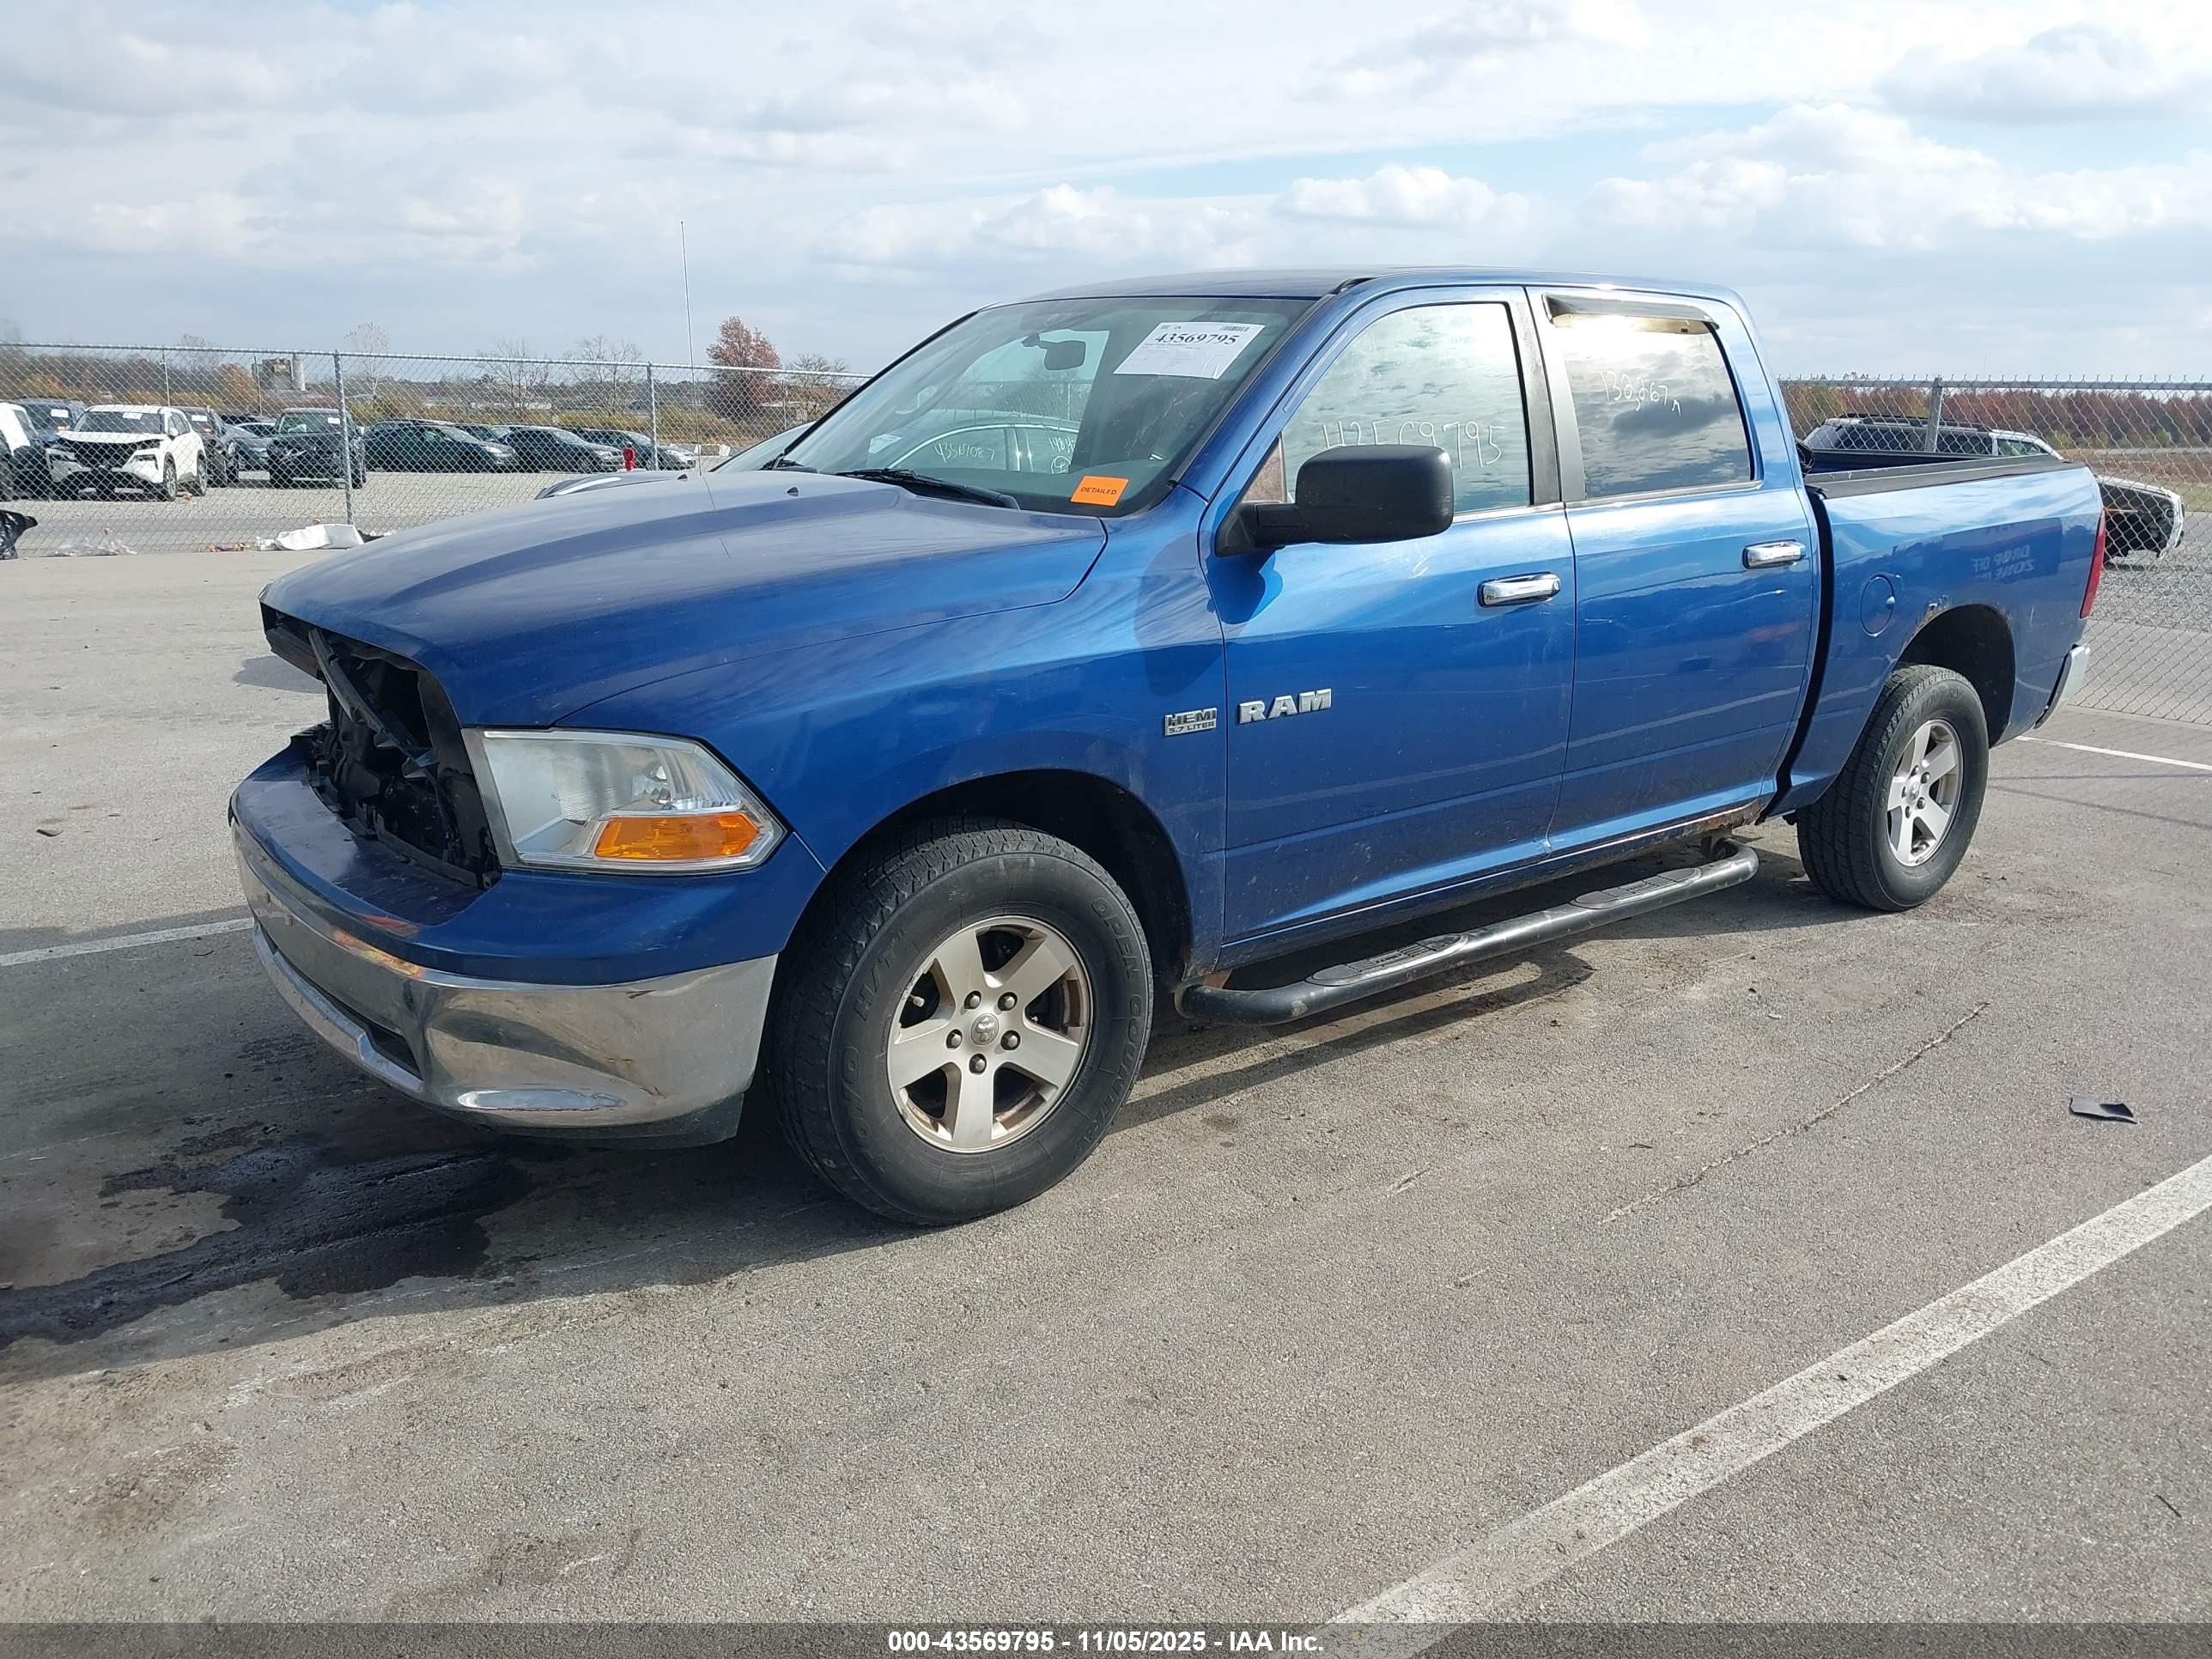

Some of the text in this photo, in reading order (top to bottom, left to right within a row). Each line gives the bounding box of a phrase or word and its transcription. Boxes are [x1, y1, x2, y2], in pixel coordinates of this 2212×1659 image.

[1155, 332, 1239, 344] 43569795
[1080, 486, 1117, 495] DETAILED
[1238, 689, 1332, 724] RAM
[1166, 708, 1217, 726] HEMI
[1168, 721, 1215, 734] 5.7 LITER
[1074, 897, 1144, 1161] OPEN COUNTRY
